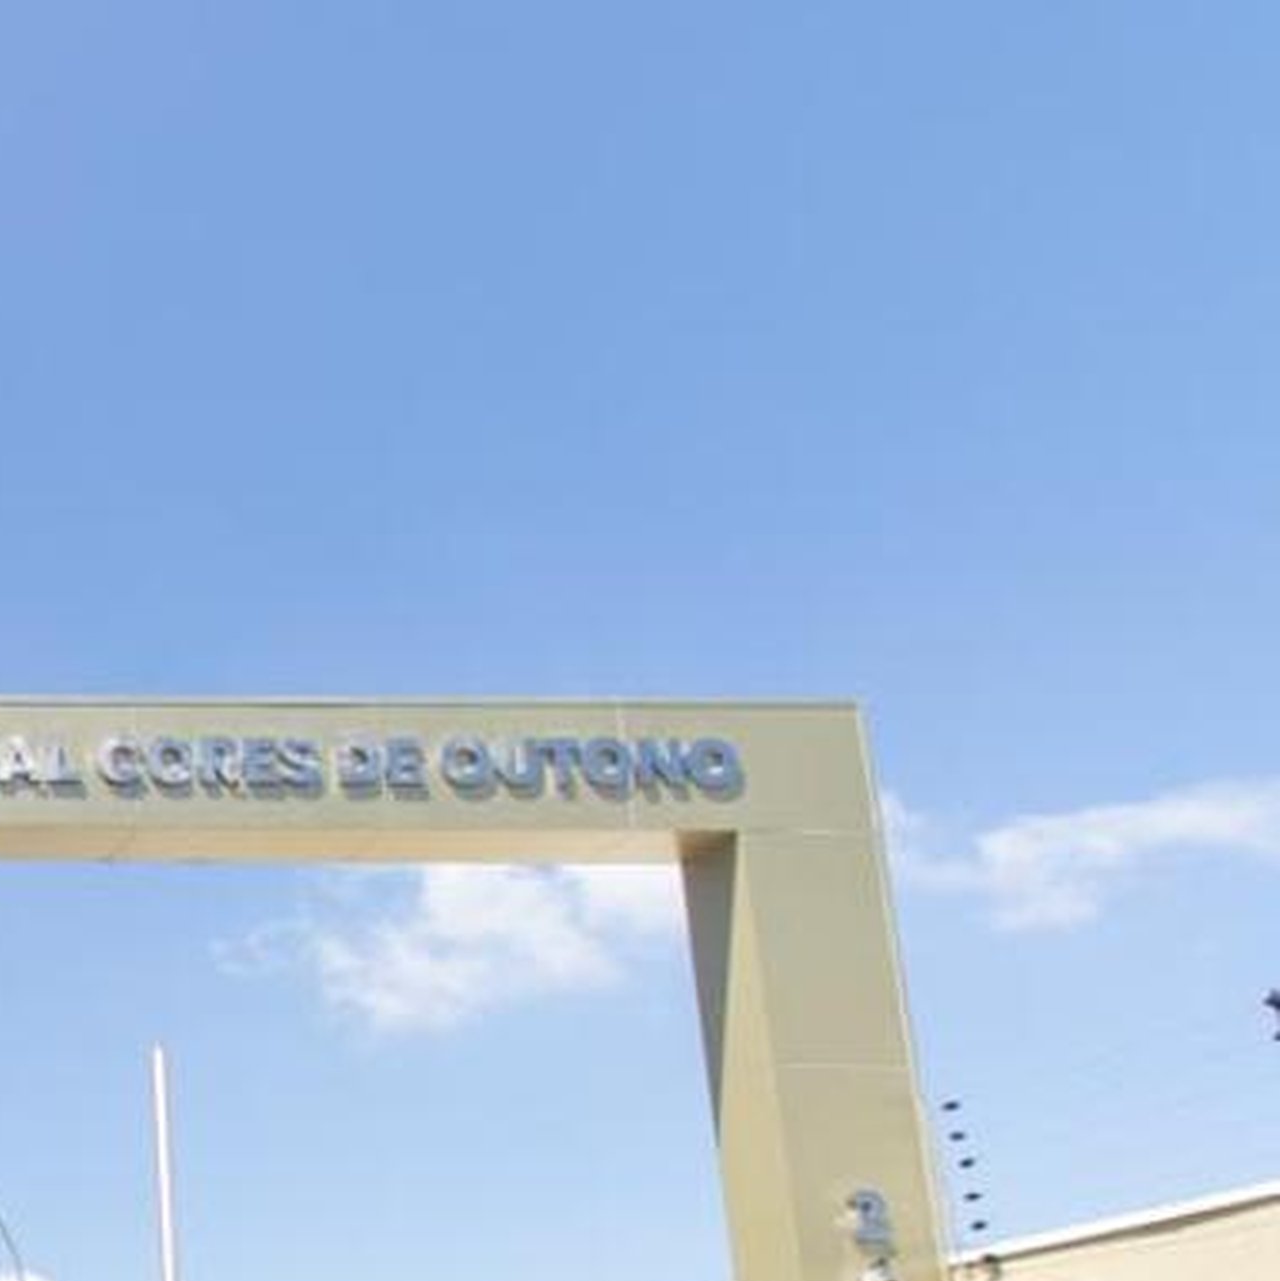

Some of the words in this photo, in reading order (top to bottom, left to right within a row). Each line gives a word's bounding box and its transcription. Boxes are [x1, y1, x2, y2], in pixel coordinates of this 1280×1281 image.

[95, 735, 324, 798] CORES
[334, 737, 430, 798] DE
[439, 737, 744, 800] OUTONO
